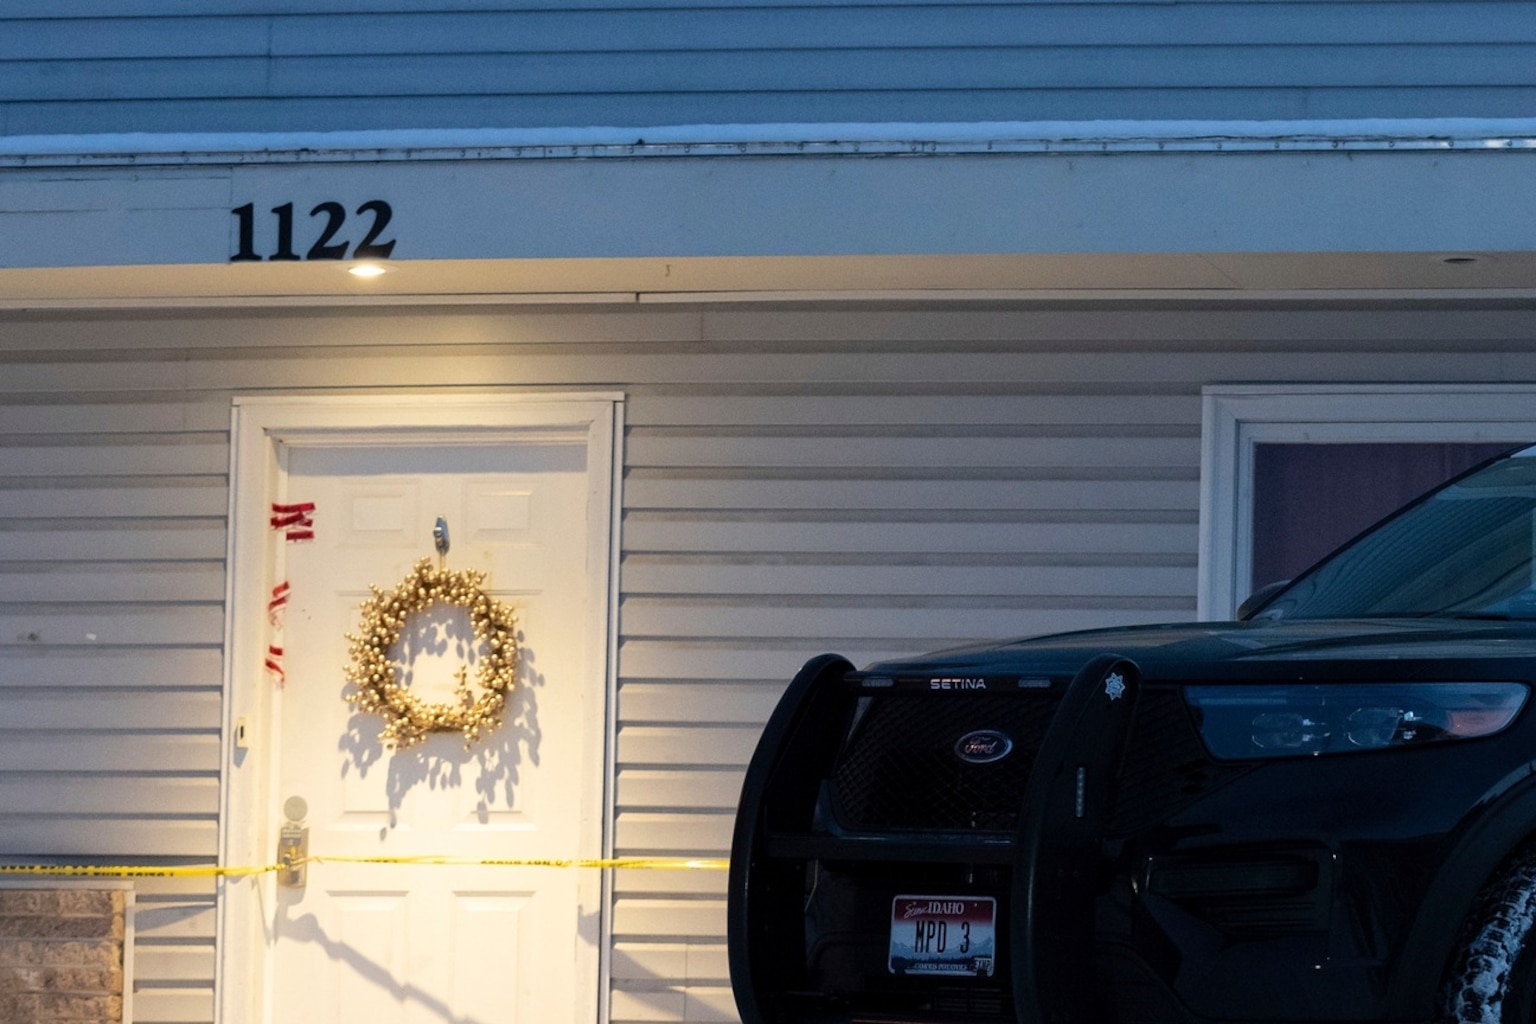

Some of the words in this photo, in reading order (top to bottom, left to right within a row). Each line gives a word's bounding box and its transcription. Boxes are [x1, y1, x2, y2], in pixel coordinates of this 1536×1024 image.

[230, 200, 396, 261] 1122
[930, 678, 986, 690] SETINA
[964, 736, 998, 754] Ford
[928, 901, 965, 915] IDAHO
[915, 920, 947, 953] MPD
[961, 921, 970, 953] 3
